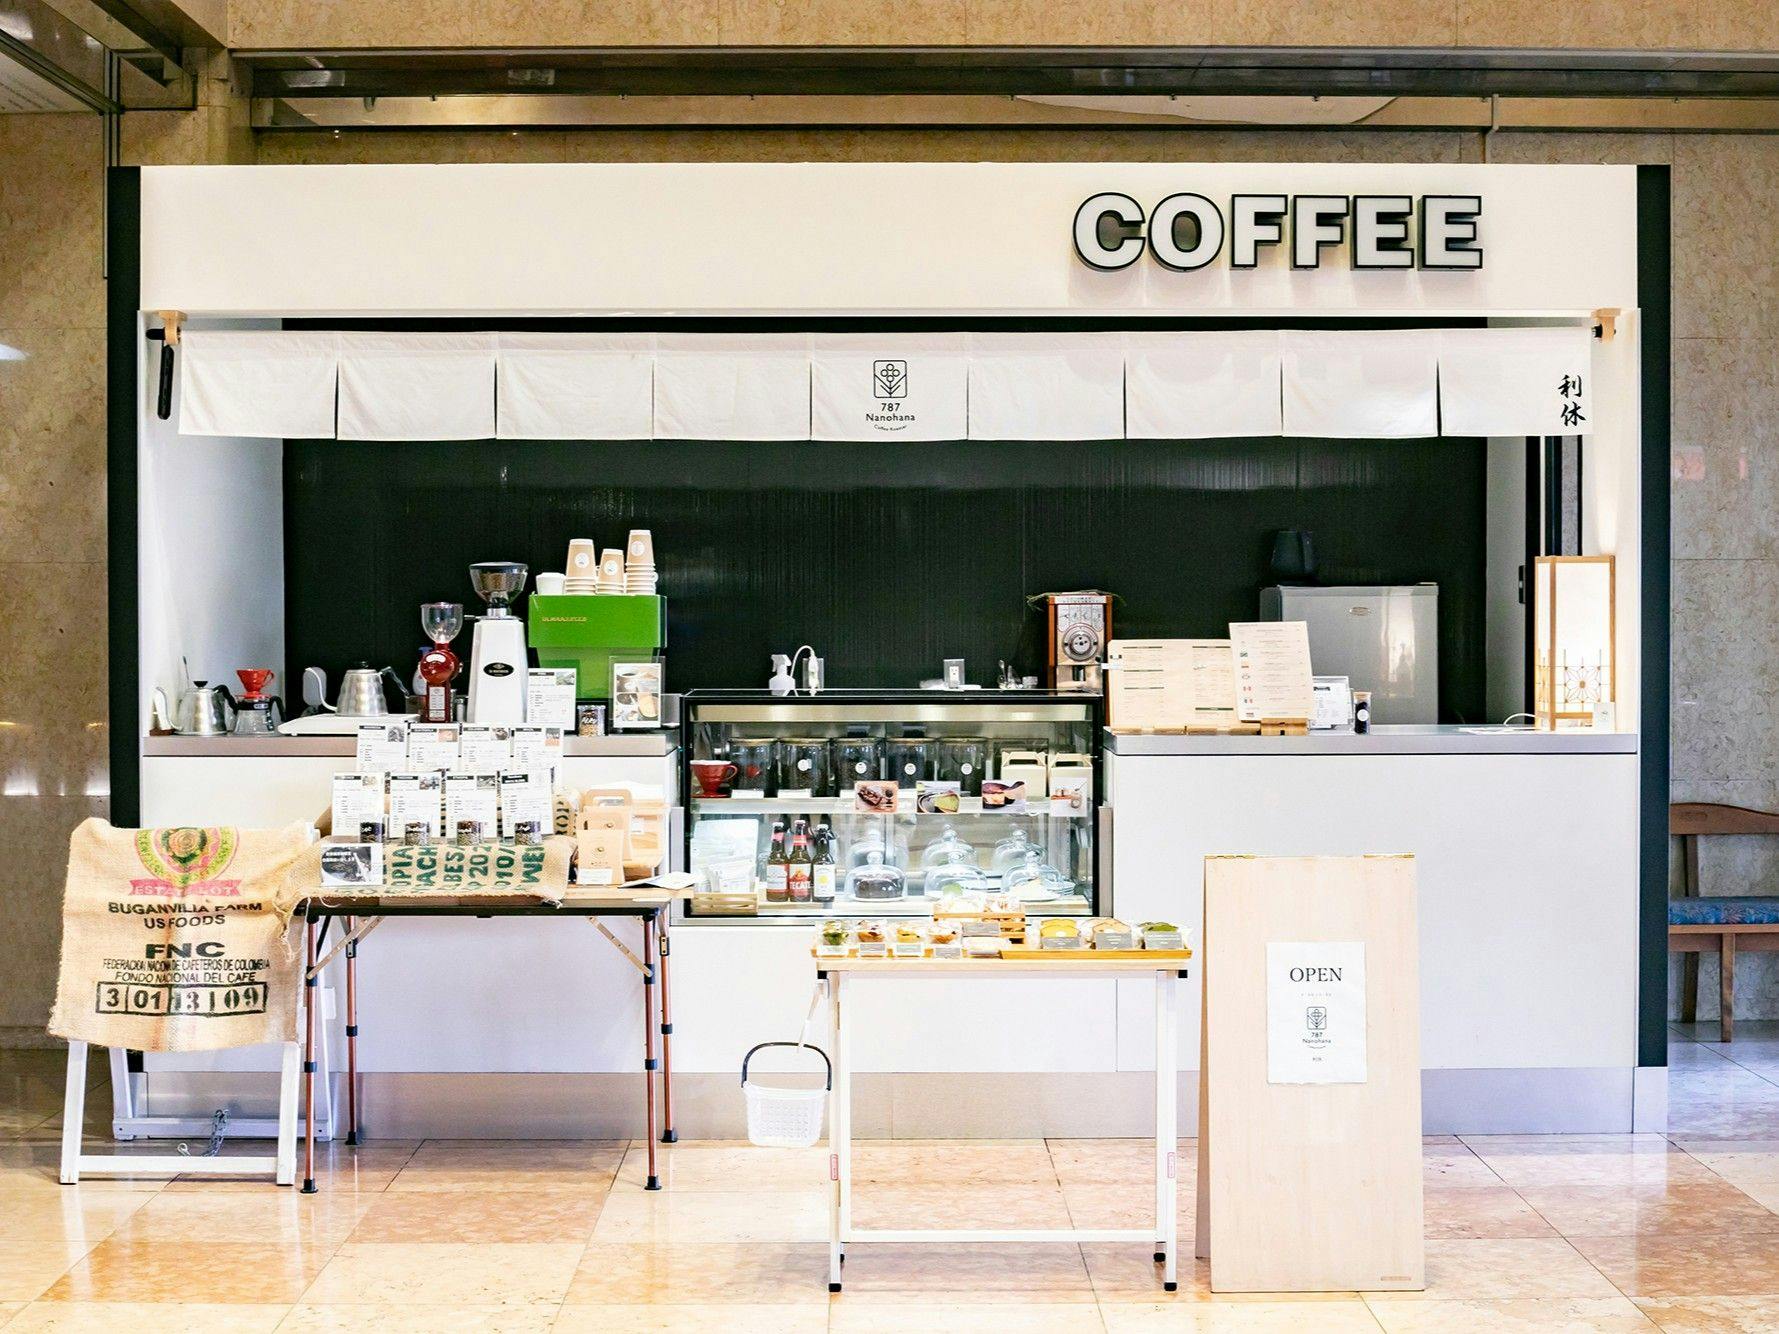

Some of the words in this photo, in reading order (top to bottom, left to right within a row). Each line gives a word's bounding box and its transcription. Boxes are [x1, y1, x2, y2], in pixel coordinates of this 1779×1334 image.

[1072, 192, 1483, 271] COFFEE
[881, 402, 900, 411] 787
[1557, 374, 1587, 427] 利休
[865, 413, 915, 421] Nanohana
[144, 917, 166, 929] US
[168, 915, 225, 928] FOODS
[145, 941, 226, 959] FNC
[182, 958, 223, 971] CAFETEROS
[223, 959, 233, 971] DE
[115, 971, 154, 983] FONDO
[155, 972, 200, 984] NACIONAL
[203, 972, 224, 983] DEL
[227, 971, 257, 983] CAFE
[1289, 967, 1342, 982] OPEN
[106, 988, 119, 1008] 3
